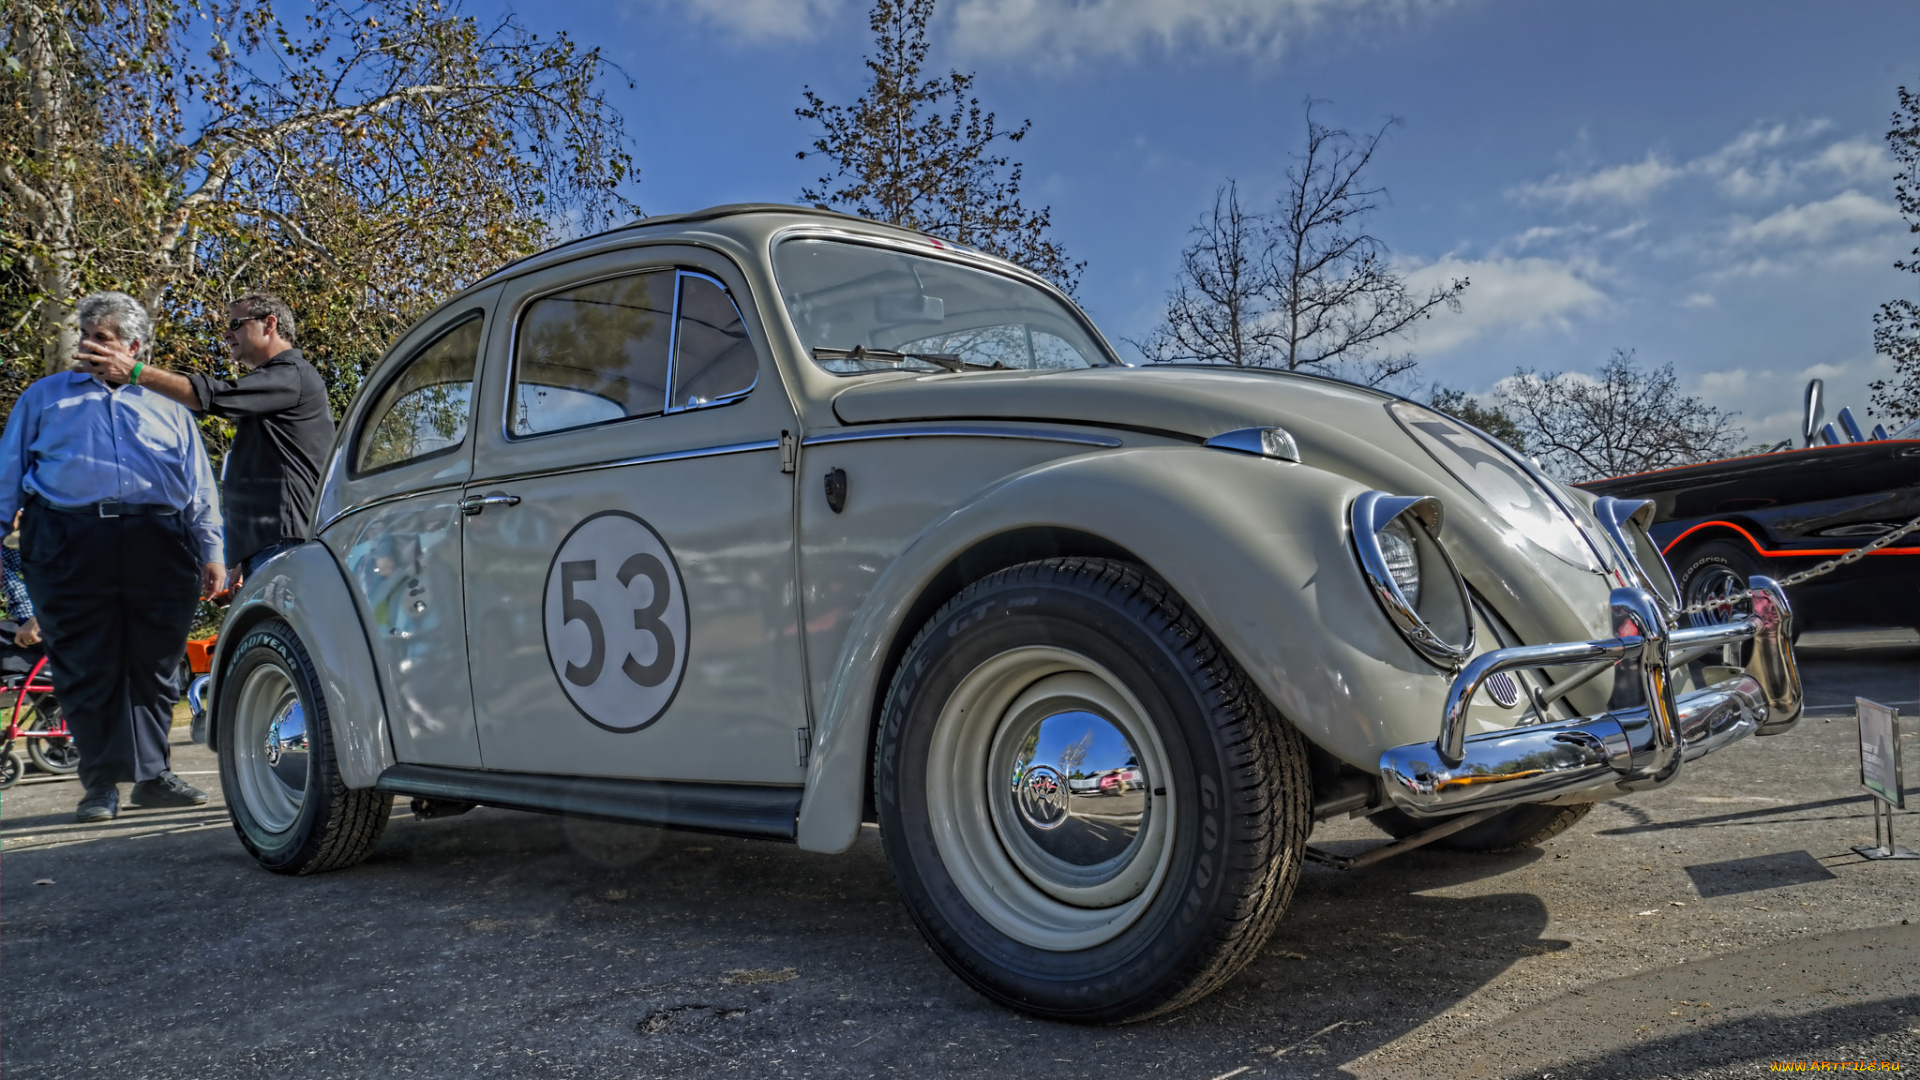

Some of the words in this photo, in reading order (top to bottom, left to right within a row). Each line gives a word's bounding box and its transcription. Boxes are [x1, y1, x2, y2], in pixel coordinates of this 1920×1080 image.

[561, 553, 675, 687] 53
[1680, 556, 1728, 594] FGoodrich
[882, 647, 930, 805] EAGLE
[948, 600, 996, 638] GT
